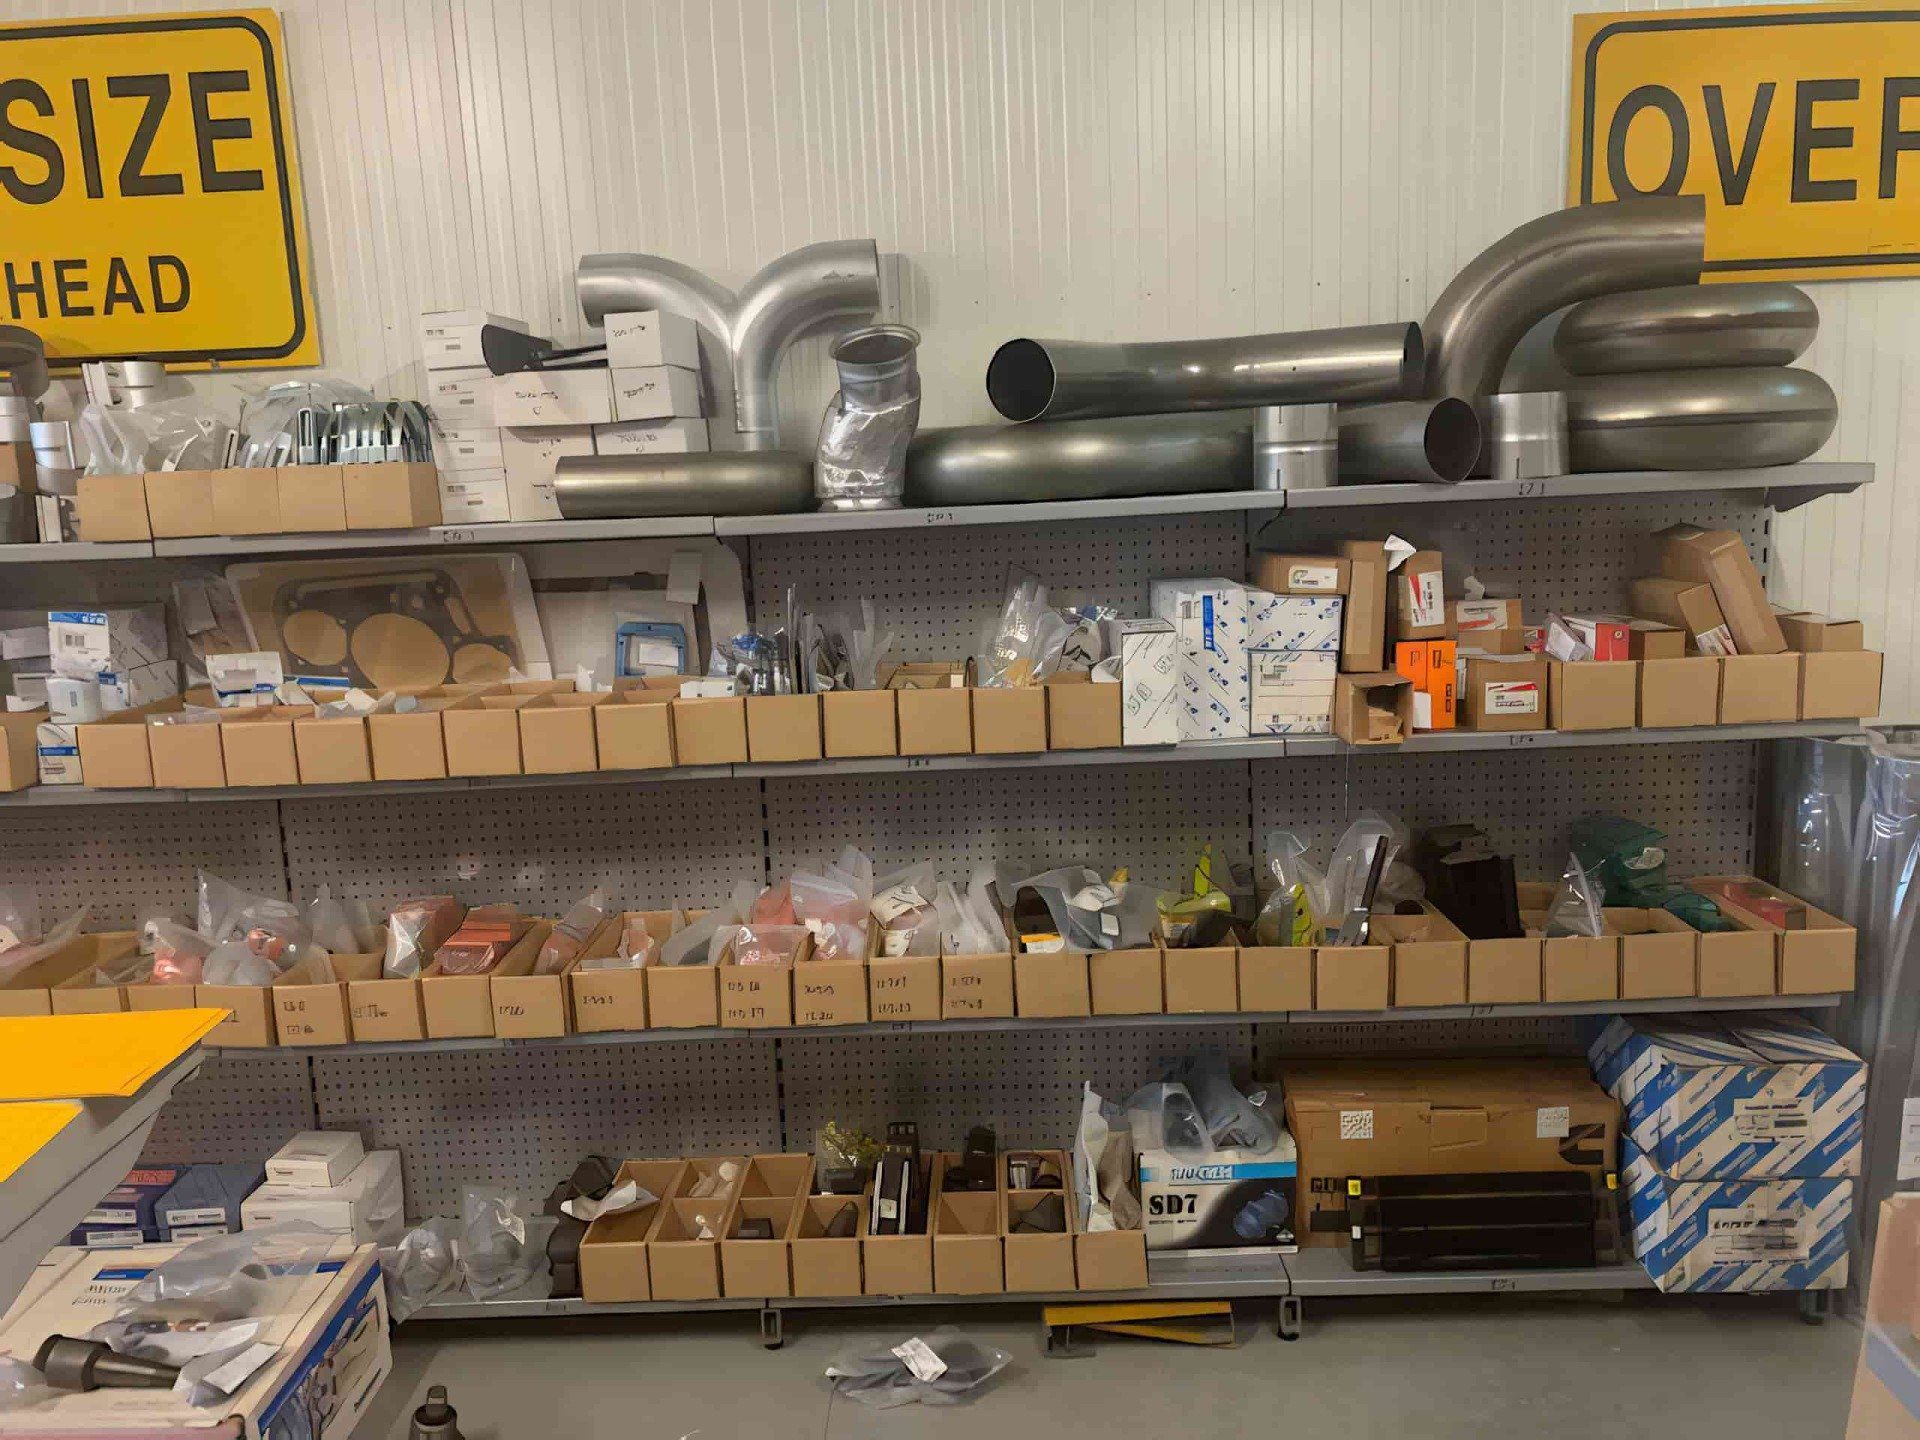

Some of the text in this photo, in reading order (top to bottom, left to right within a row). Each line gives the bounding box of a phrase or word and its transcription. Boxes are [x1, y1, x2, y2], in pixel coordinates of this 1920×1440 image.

[0, 70, 264, 205] SIZE
[4, 254, 191, 320] HEAD
[1149, 1194, 1198, 1216] SD7
